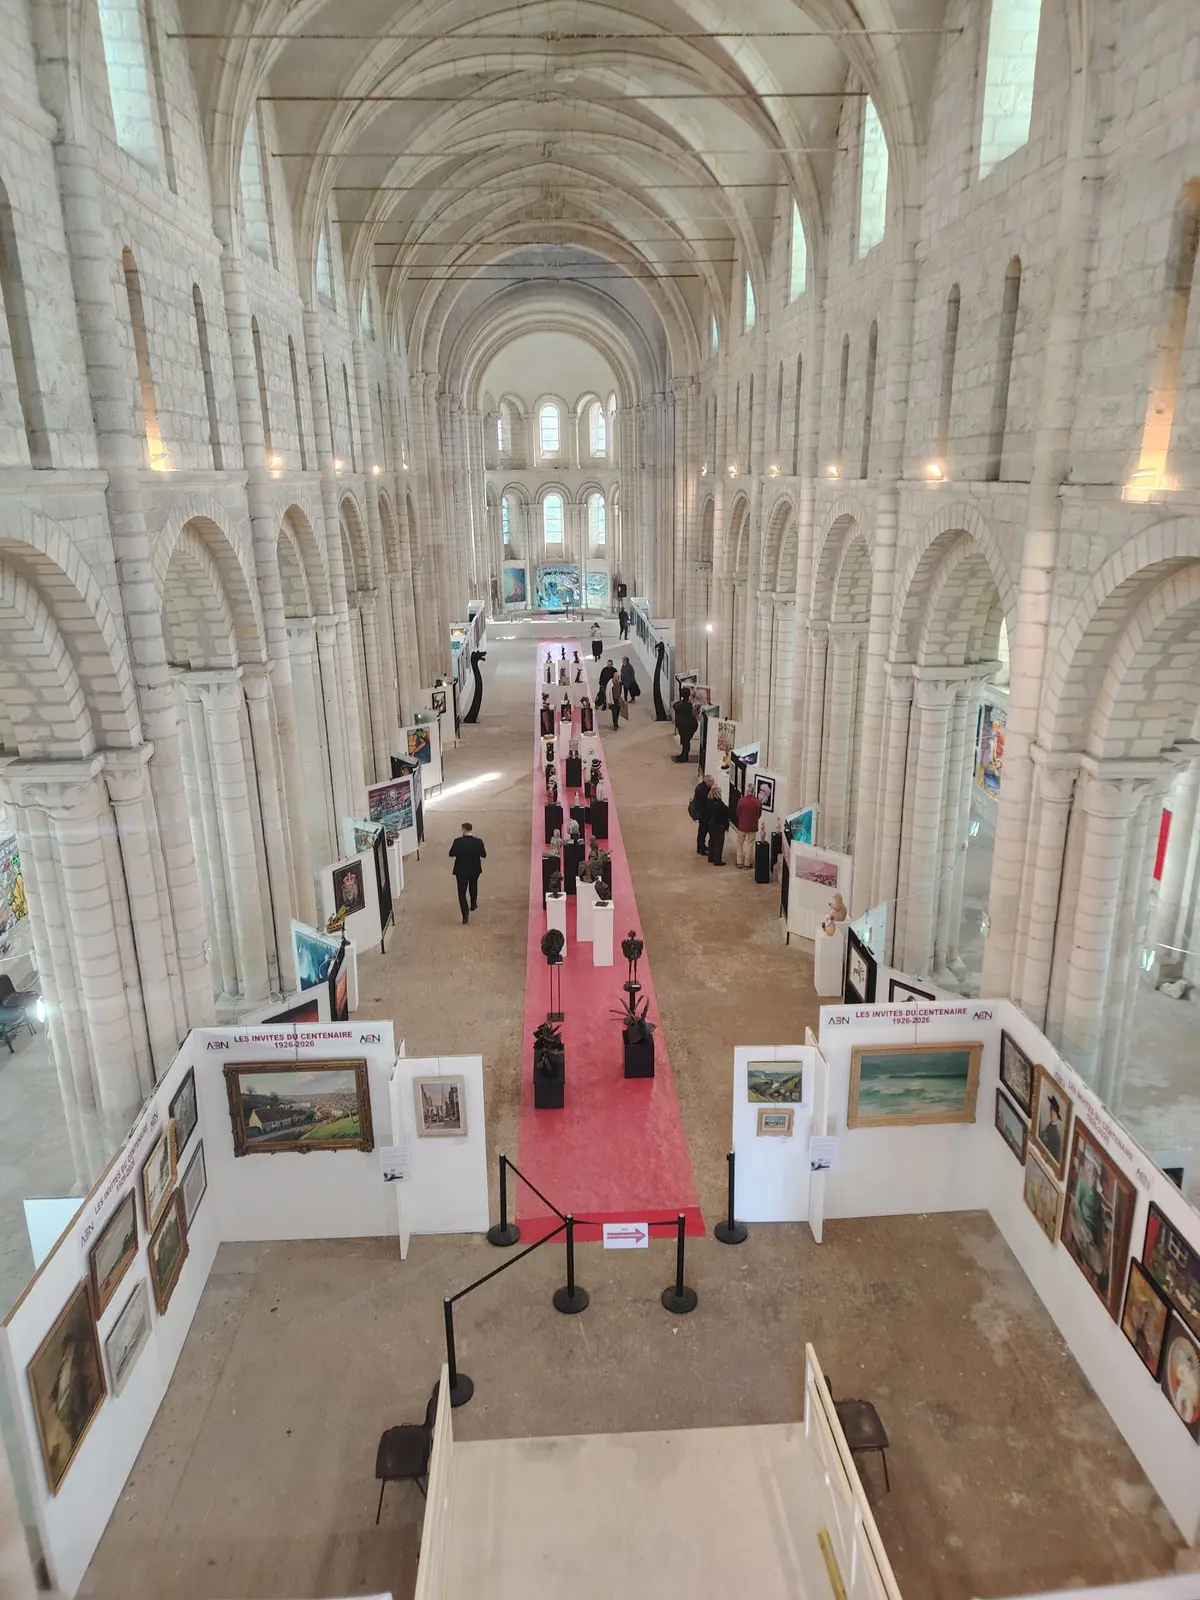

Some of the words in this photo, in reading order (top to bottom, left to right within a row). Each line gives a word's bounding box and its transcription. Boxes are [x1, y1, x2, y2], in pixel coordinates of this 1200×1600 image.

[905, 1009, 916, 1017] DU
[918, 1008, 968, 1016] CENTENAIRE
[892, 1017, 930, 1025] 1926-2026
[286, 1033, 299, 1041] DU
[300, 1031, 353, 1040] CENTENAIRE
[274, 1040, 315, 1049] 1926-2026
[94, 1197, 104, 1216] LES
